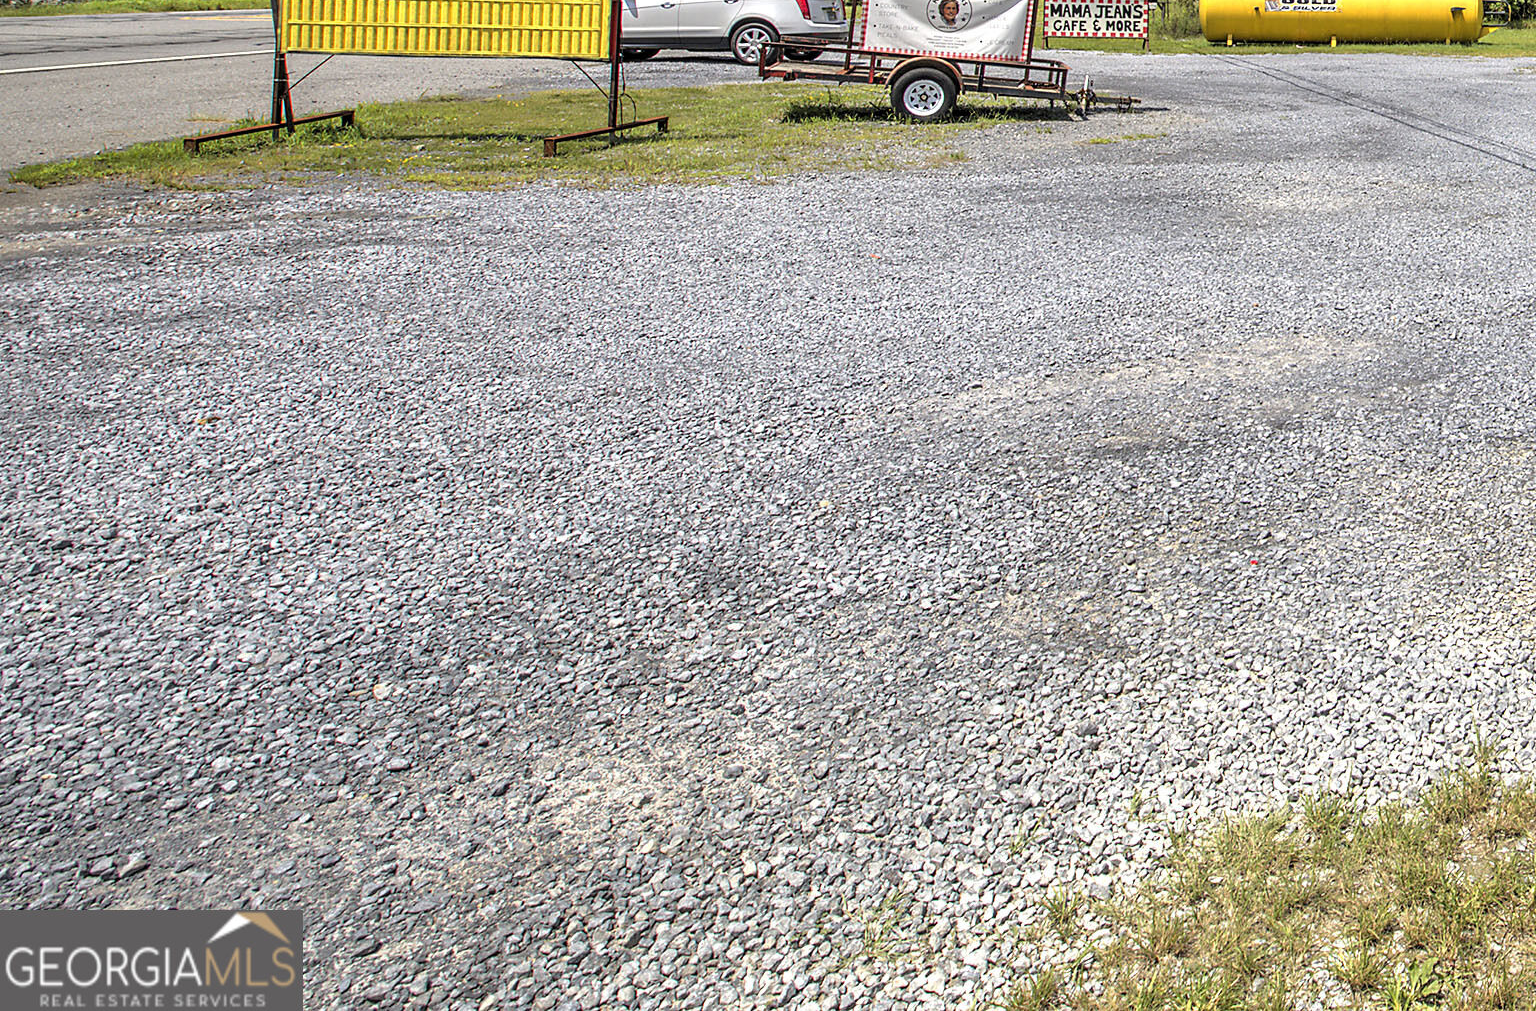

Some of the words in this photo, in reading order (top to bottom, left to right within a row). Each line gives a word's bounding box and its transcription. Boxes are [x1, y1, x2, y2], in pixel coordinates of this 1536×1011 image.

[1050, 3, 1091, 18] MAMA
[1094, 3, 1143, 19] JEAN'S
[1053, 20, 1087, 31] CAFE
[1093, 19, 1101, 31] &
[1106, 20, 1141, 32] MORE
